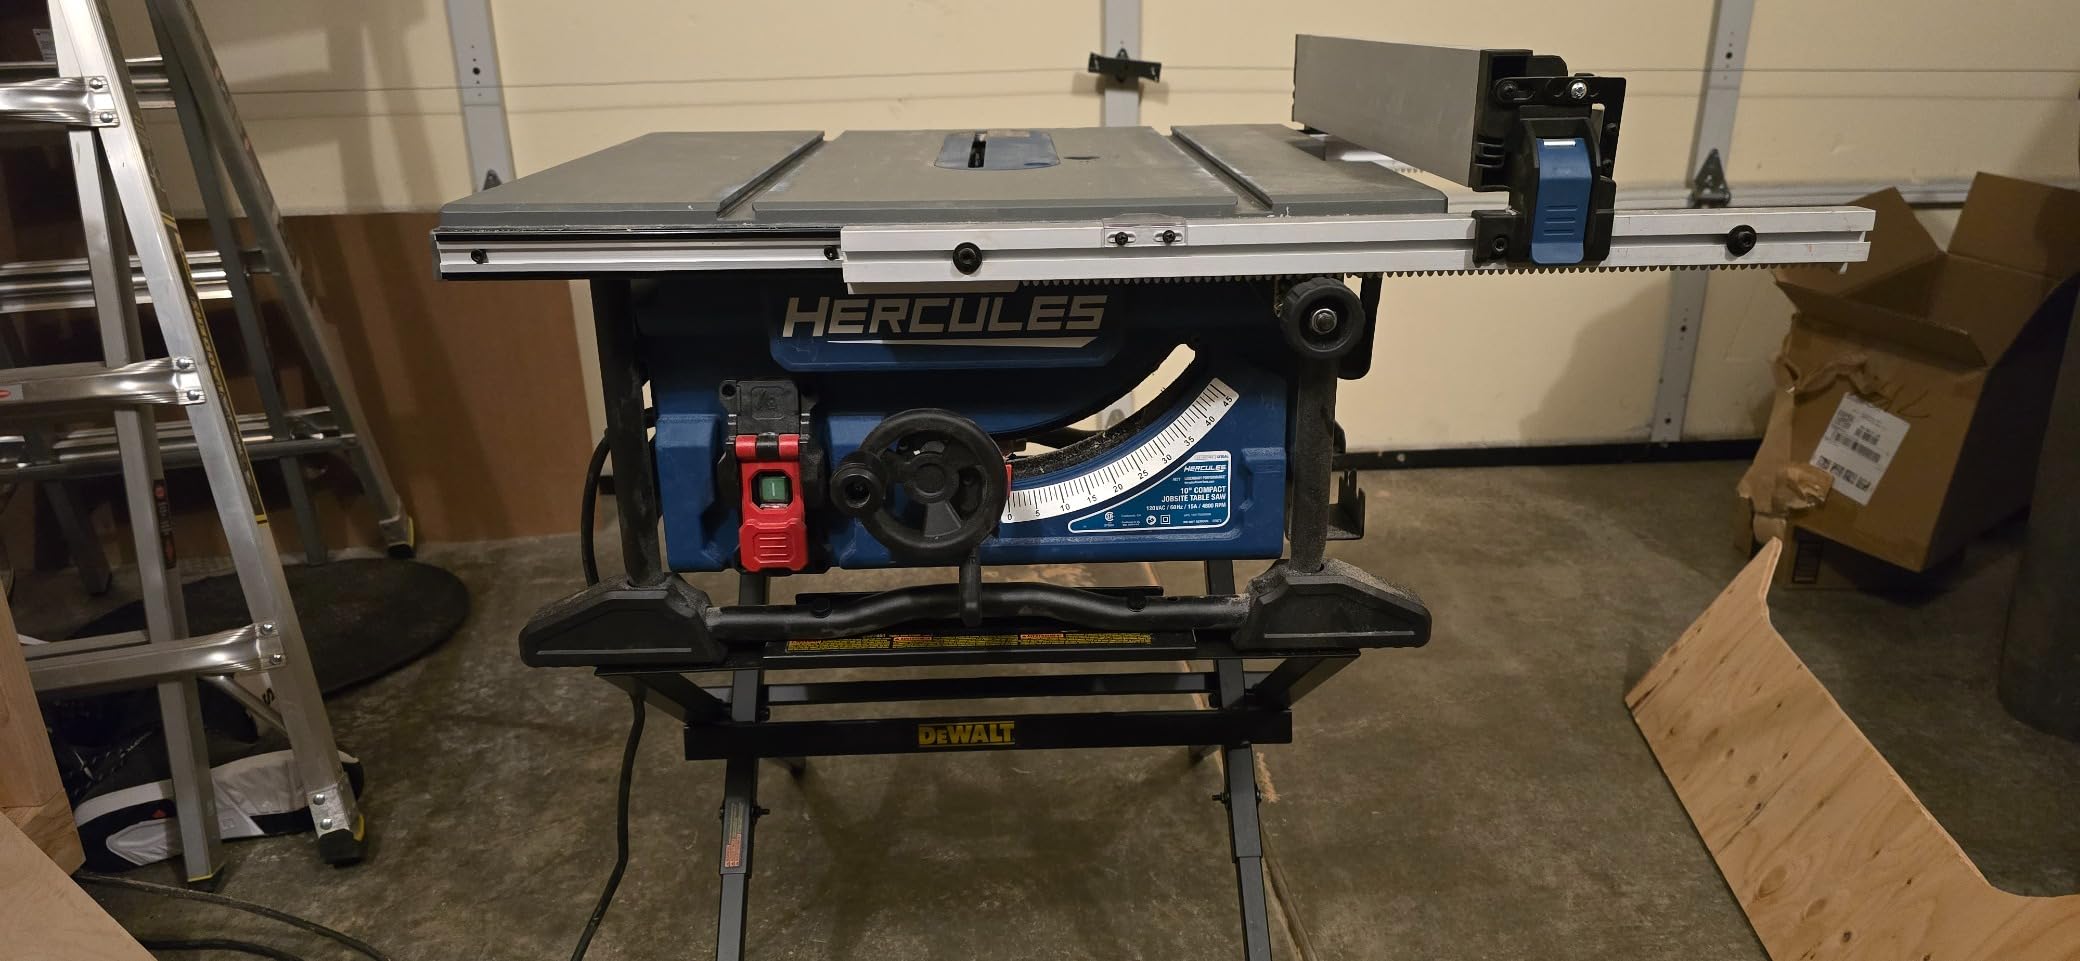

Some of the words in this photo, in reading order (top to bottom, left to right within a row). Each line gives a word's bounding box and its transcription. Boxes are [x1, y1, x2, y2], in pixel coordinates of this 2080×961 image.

[782, 295, 1107, 338] HERCULES
[1223, 395, 1233, 407] 45
[1205, 415, 1215, 427] 40
[1184, 435, 1195, 447] 35
[1162, 454, 1172, 464] 30
[1183, 464, 1227, 473] HERCULES
[1138, 469, 1149, 480] 25
[1112, 483, 1124, 493] 20
[1194, 485, 1227, 494] COMPACT
[1086, 494, 1097, 504] 15
[1161, 494, 1189, 503] JOBSITE
[1190, 493, 1209, 502] TABLE
[1211, 493, 1227, 501] SAW
[1060, 503, 1071, 512] 10
[1007, 513, 1013, 521] 0
[1035, 509, 1041, 517] 5
